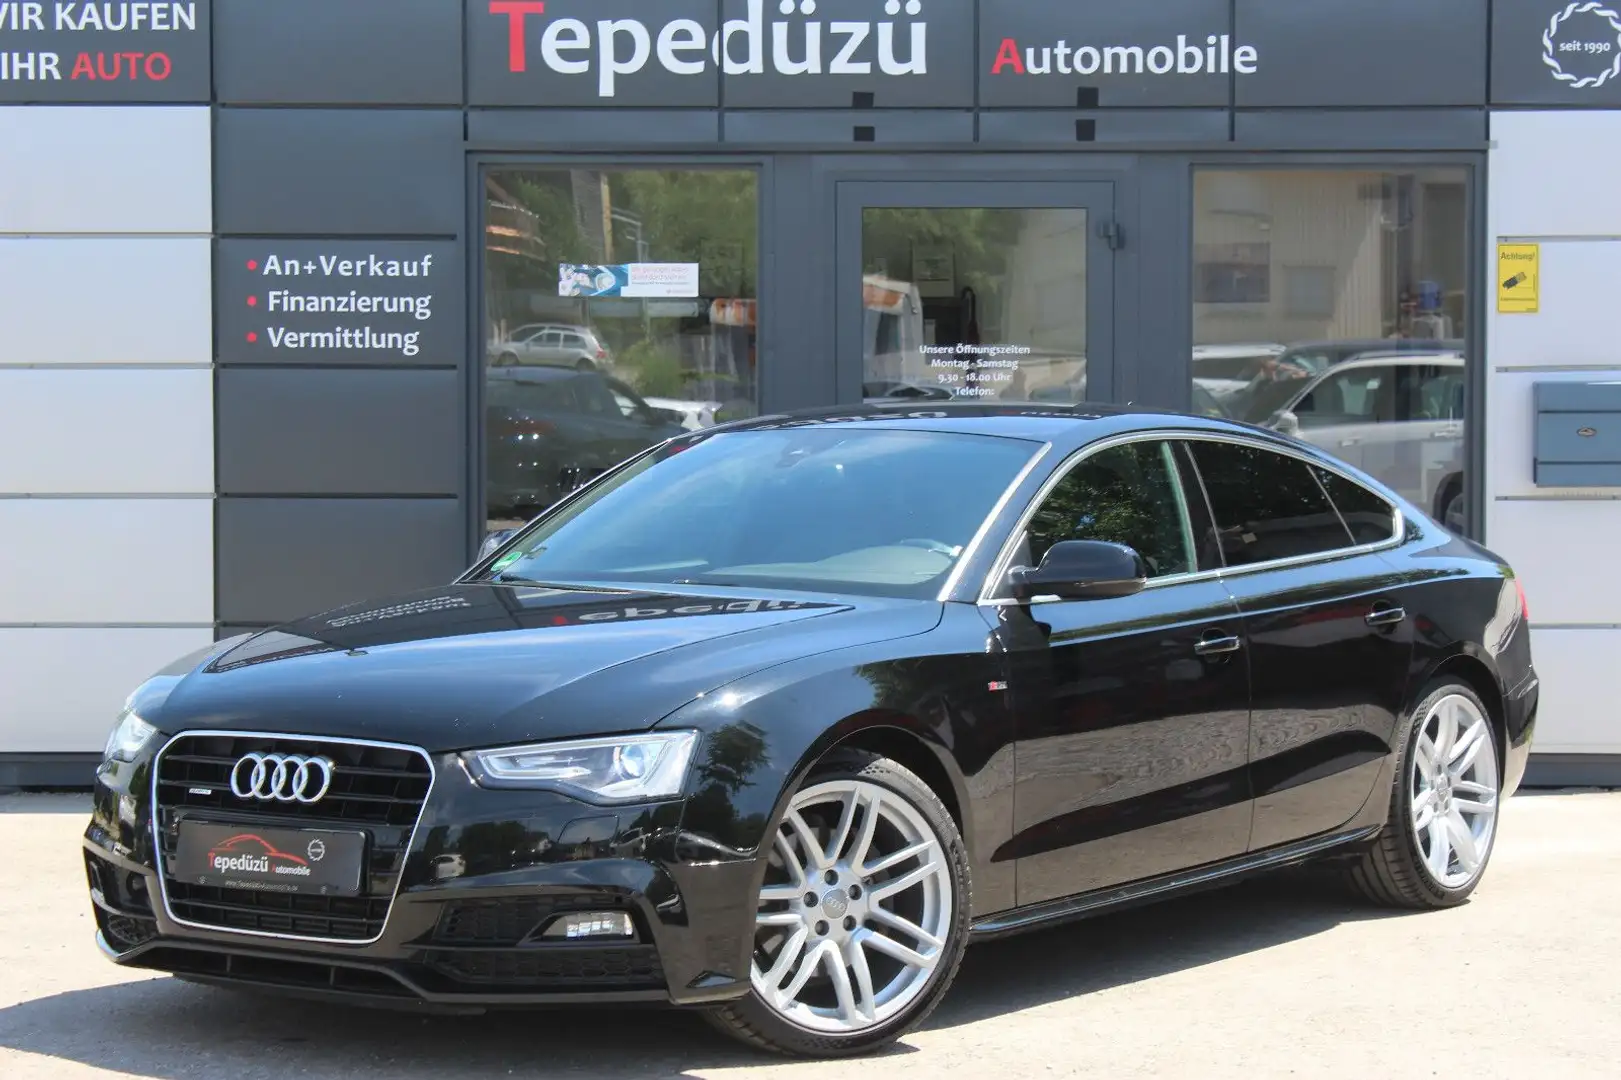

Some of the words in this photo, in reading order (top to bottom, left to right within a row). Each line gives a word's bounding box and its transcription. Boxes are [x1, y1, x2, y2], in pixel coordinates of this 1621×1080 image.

[0, 3, 45, 31] IR
[55, 2, 196, 31] KAUFEN
[489, 0, 927, 97] Tepedüzü
[991, 35, 1258, 75] Automobile
[1559, 40, 1582, 51] seit
[1584, 42, 1611, 54] 1990
[1, 52, 62, 80] IHR
[71, 52, 172, 81] AUTO
[262, 254, 432, 277] An+Verkauf
[268, 289, 432, 320] Finanzierung
[267, 326, 420, 356] Vermittlung
[919, 345, 954, 354] Unsere
[956, 343, 1031, 356] Öffnungszeiten
[931, 359, 970, 370] Montag
[977, 359, 1019, 371] Samstag
[938, 373, 959, 383] 9.30
[966, 373, 991, 381] 18.00
[993, 373, 1013, 381] Uhr
[956, 386, 995, 396] Telefon:
[208, 851, 269, 873] Tepedüzü
